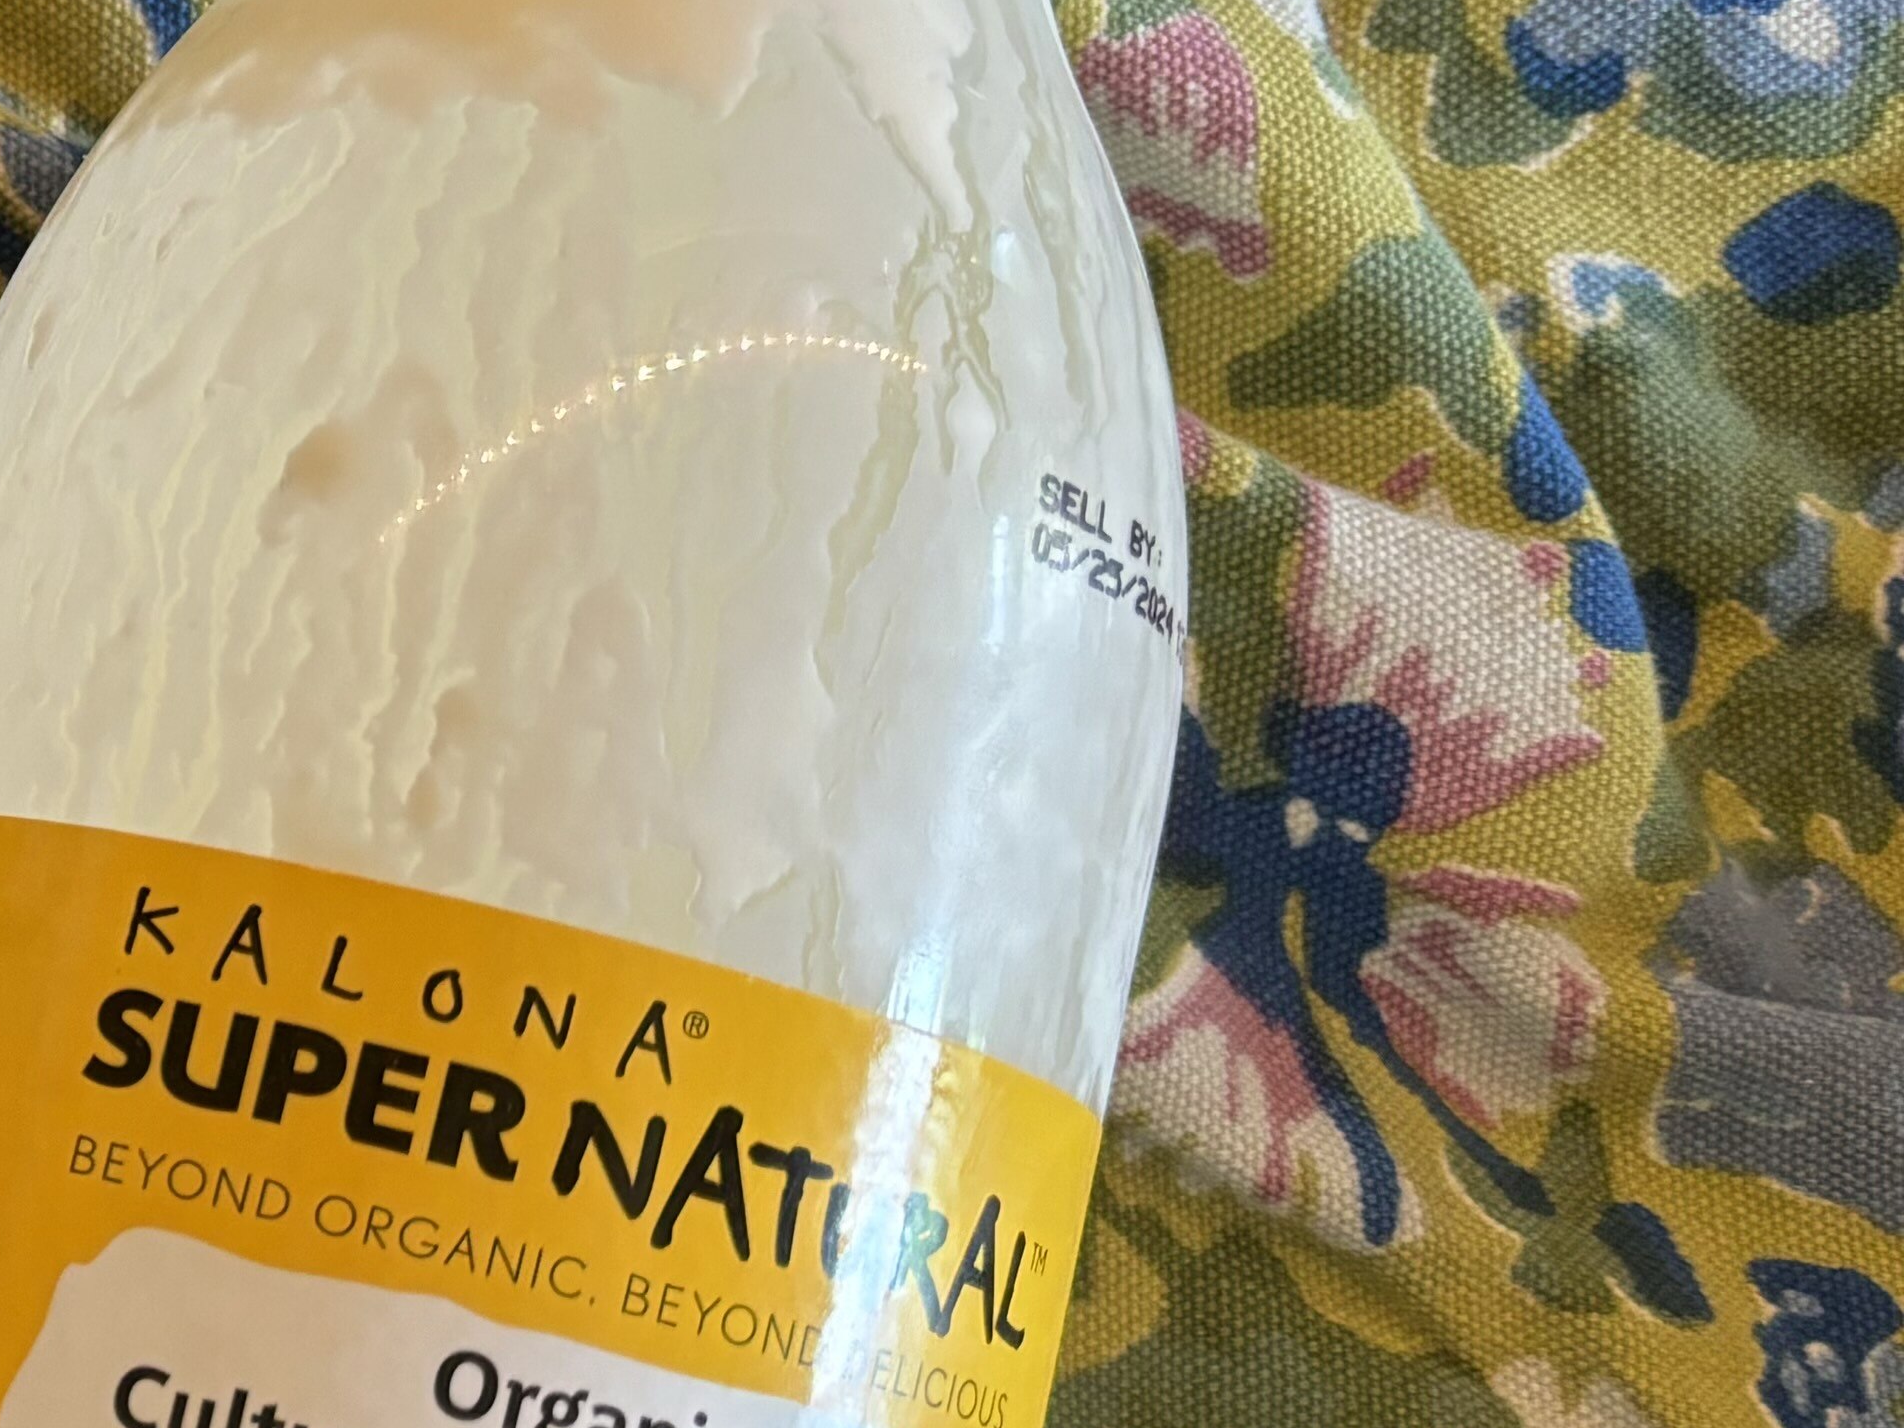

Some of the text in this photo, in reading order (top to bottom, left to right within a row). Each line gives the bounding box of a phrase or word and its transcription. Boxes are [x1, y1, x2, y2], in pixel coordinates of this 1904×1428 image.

[1039, 473, 1163, 568] SELL BY:
[80, 987, 528, 1184] SUPER
[68, 1134, 292, 1224] BEYOND
[314, 1194, 597, 1307] ORGANIC.
